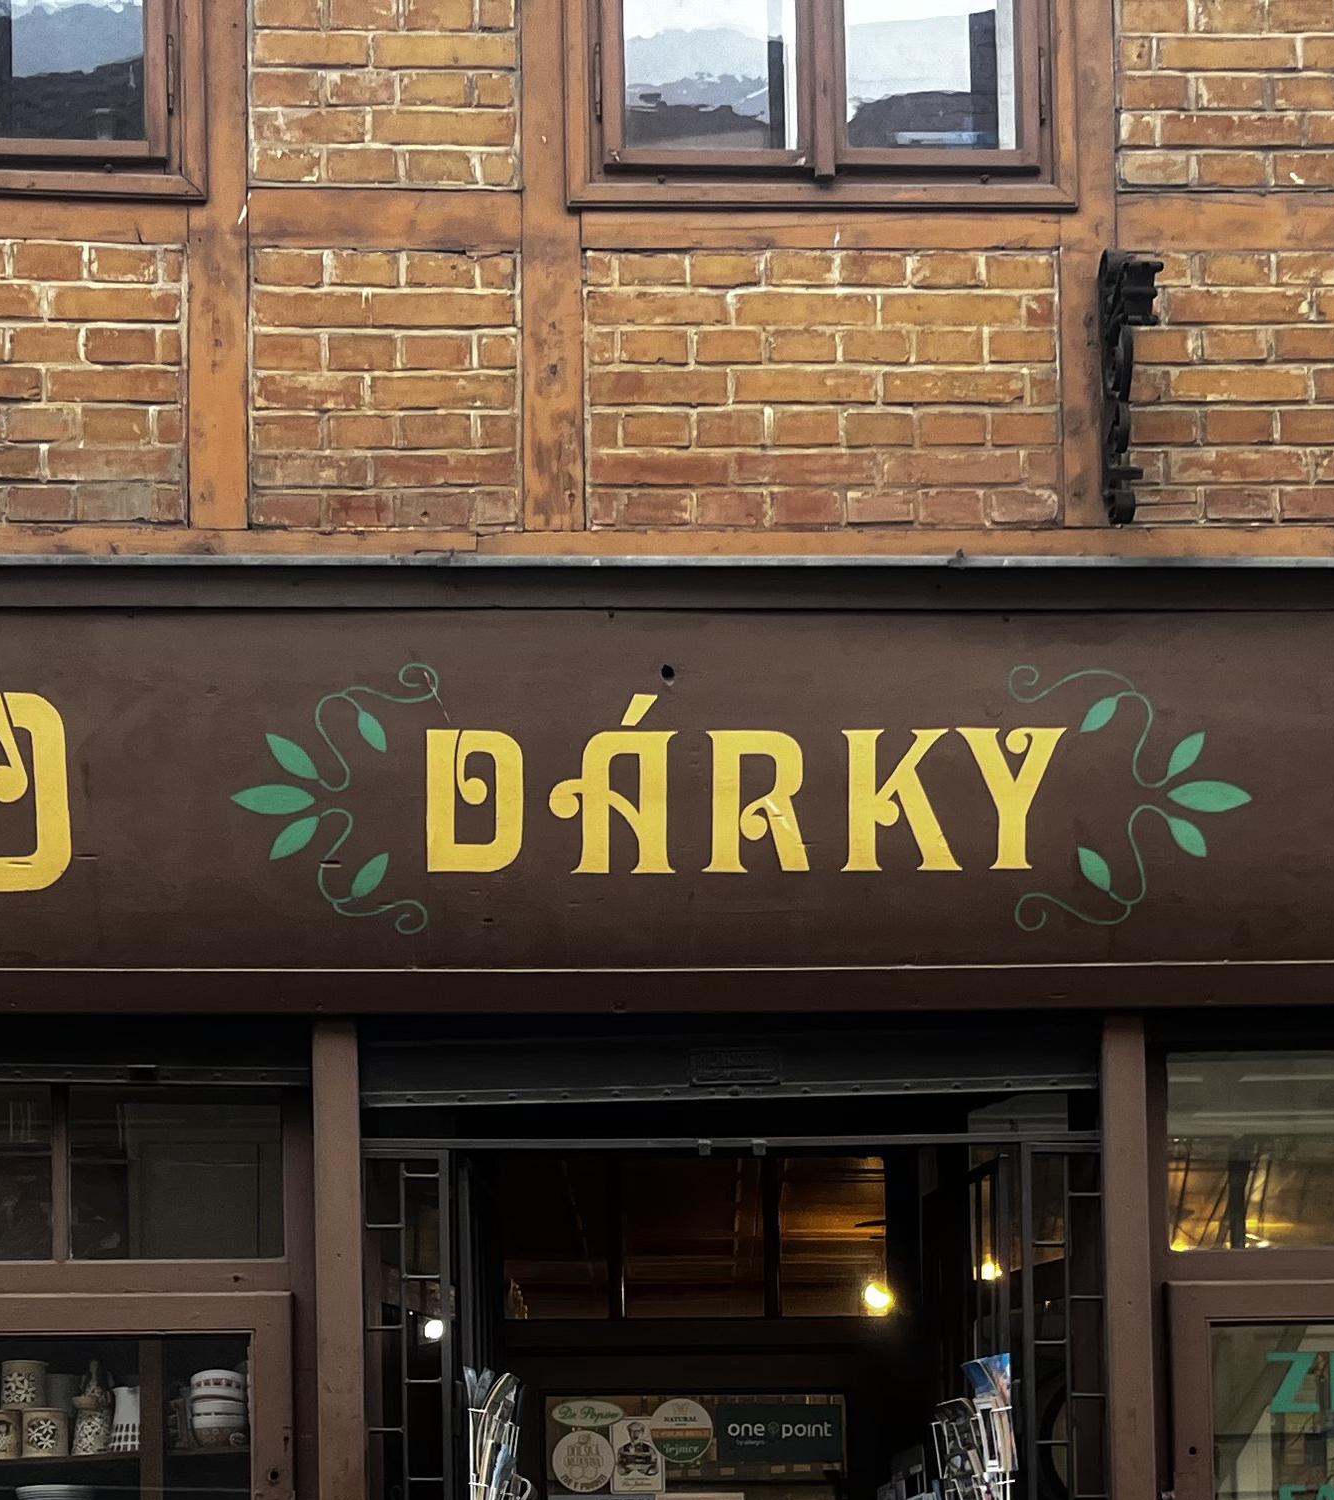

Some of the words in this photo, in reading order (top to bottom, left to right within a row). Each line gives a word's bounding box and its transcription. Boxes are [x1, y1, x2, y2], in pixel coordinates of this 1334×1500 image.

[425, 693, 1067, 874] DÁRKY
[727, 1422, 765, 1437] one
[781, 1421, 832, 1439] point
